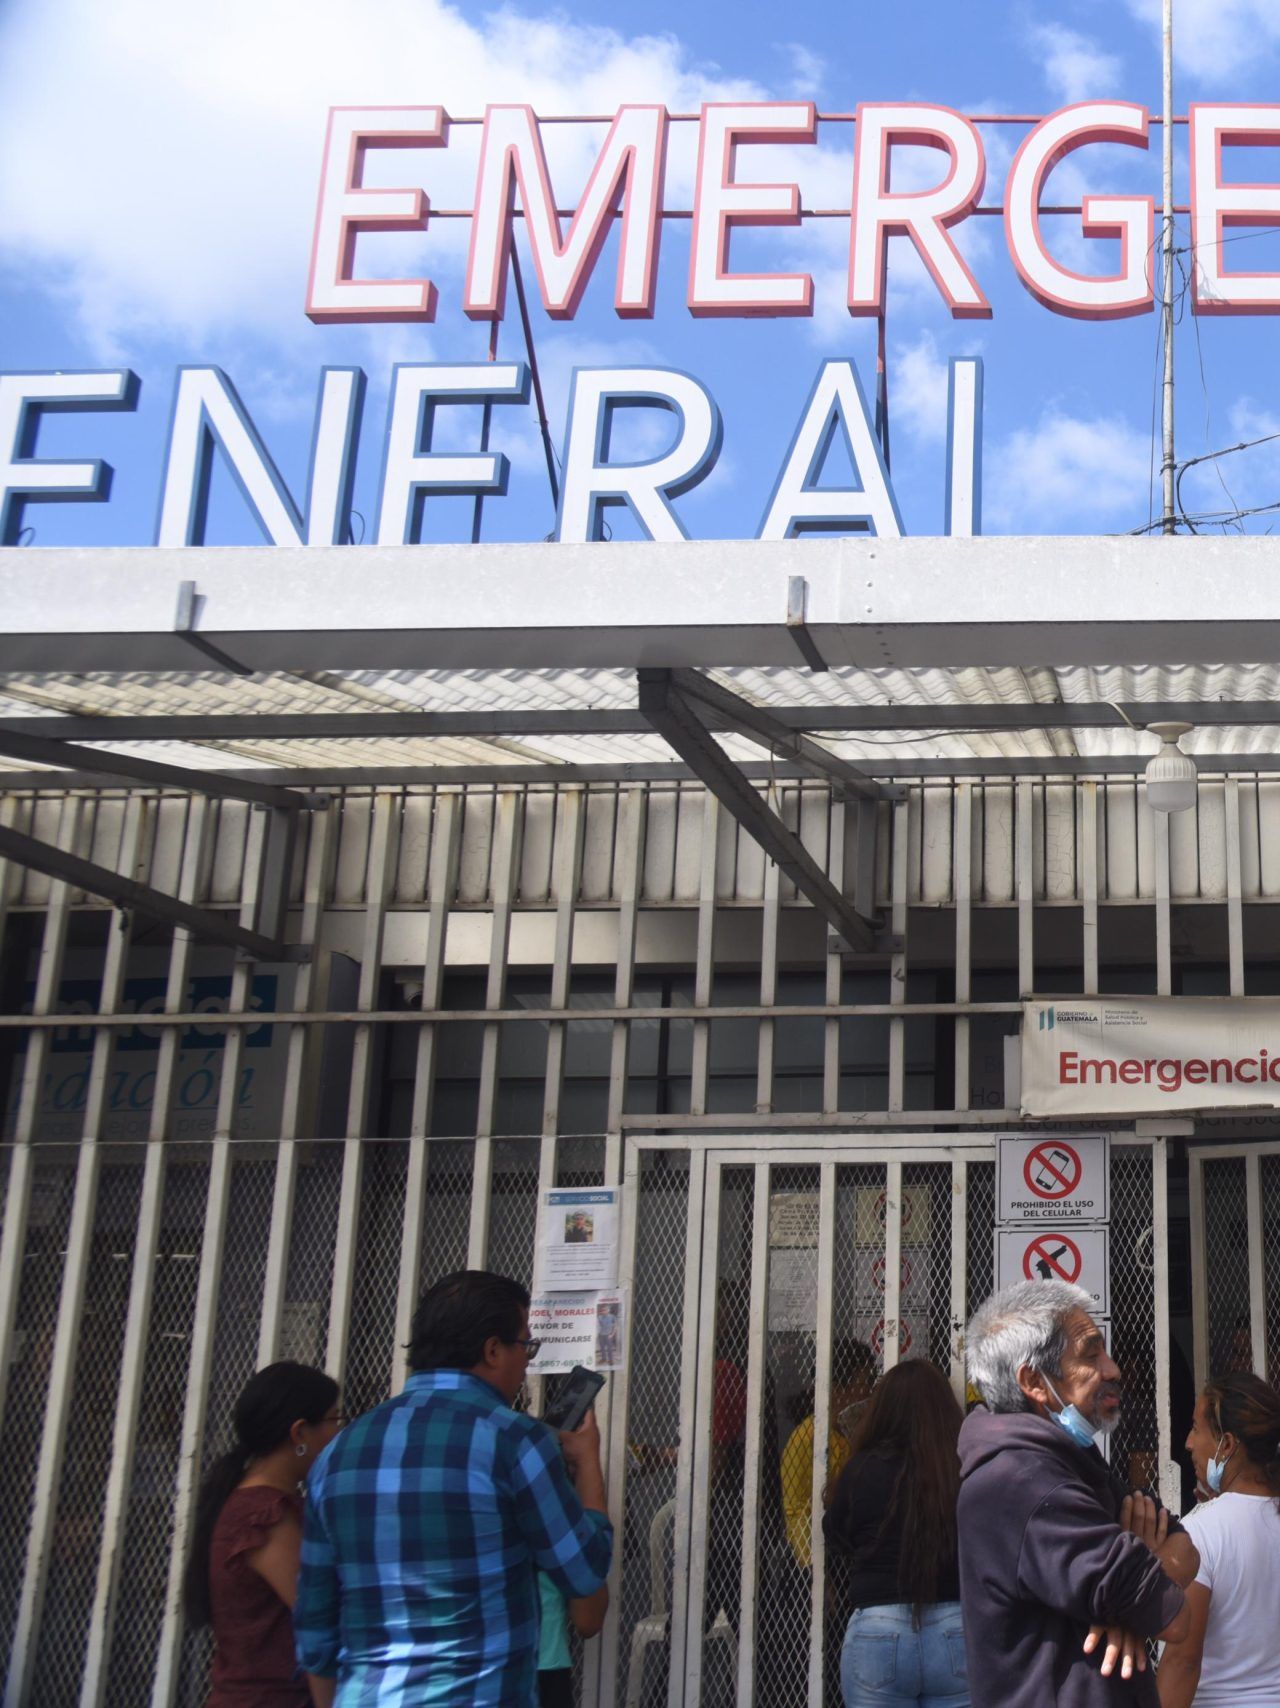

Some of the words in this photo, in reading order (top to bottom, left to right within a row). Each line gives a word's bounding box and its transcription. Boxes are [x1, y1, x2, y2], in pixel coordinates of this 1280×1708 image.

[1011, 1201, 1061, 1209] PROHIBIDO
[1063, 1200, 1073, 1208] EL
[1075, 1200, 1094, 1208] USO
[1042, 1209, 1082, 1217] CELULAR
[555, 1307, 595, 1317] MORALES
[561, 1321, 575, 1330] DE
